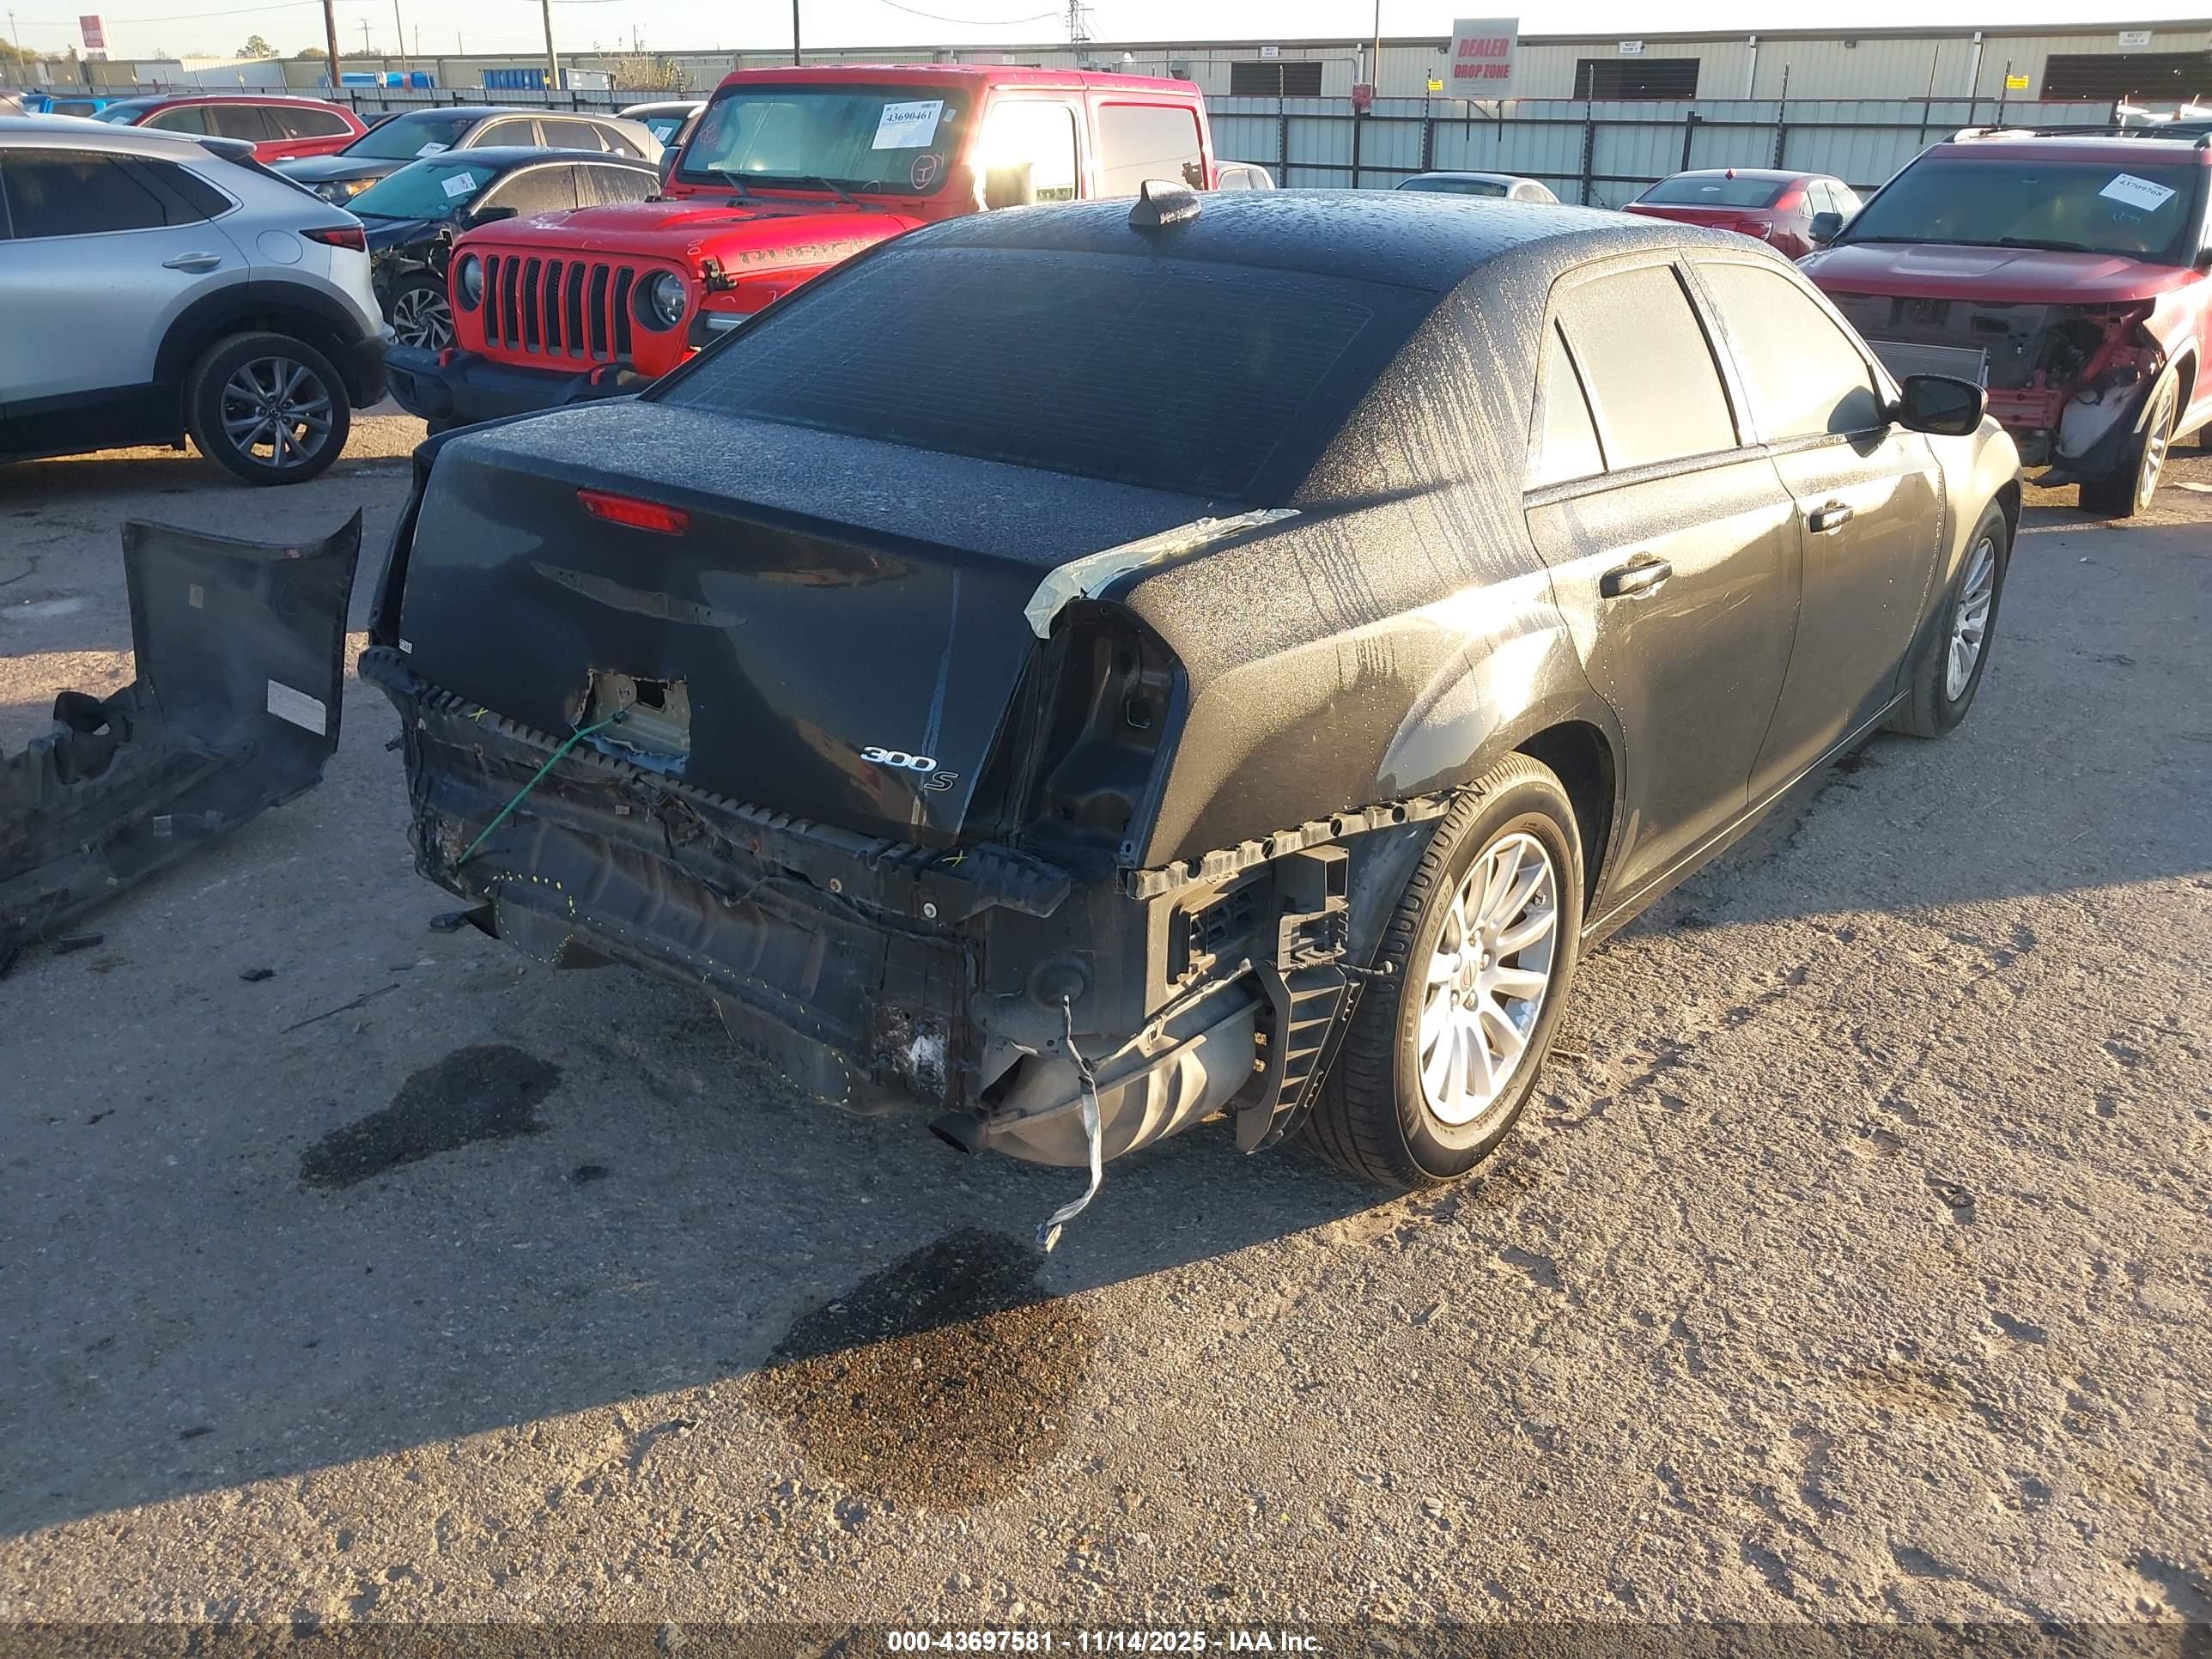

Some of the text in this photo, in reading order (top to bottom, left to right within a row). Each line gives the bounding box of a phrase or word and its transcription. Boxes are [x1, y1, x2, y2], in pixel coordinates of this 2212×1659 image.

[1457, 38, 1510, 58] DEALER
[1454, 64, 1510, 79] DROP ZONE
[886, 111, 933, 123] 43690461
[2118, 179, 2164, 197] 43709768
[1443, 884, 1450, 900] 17
